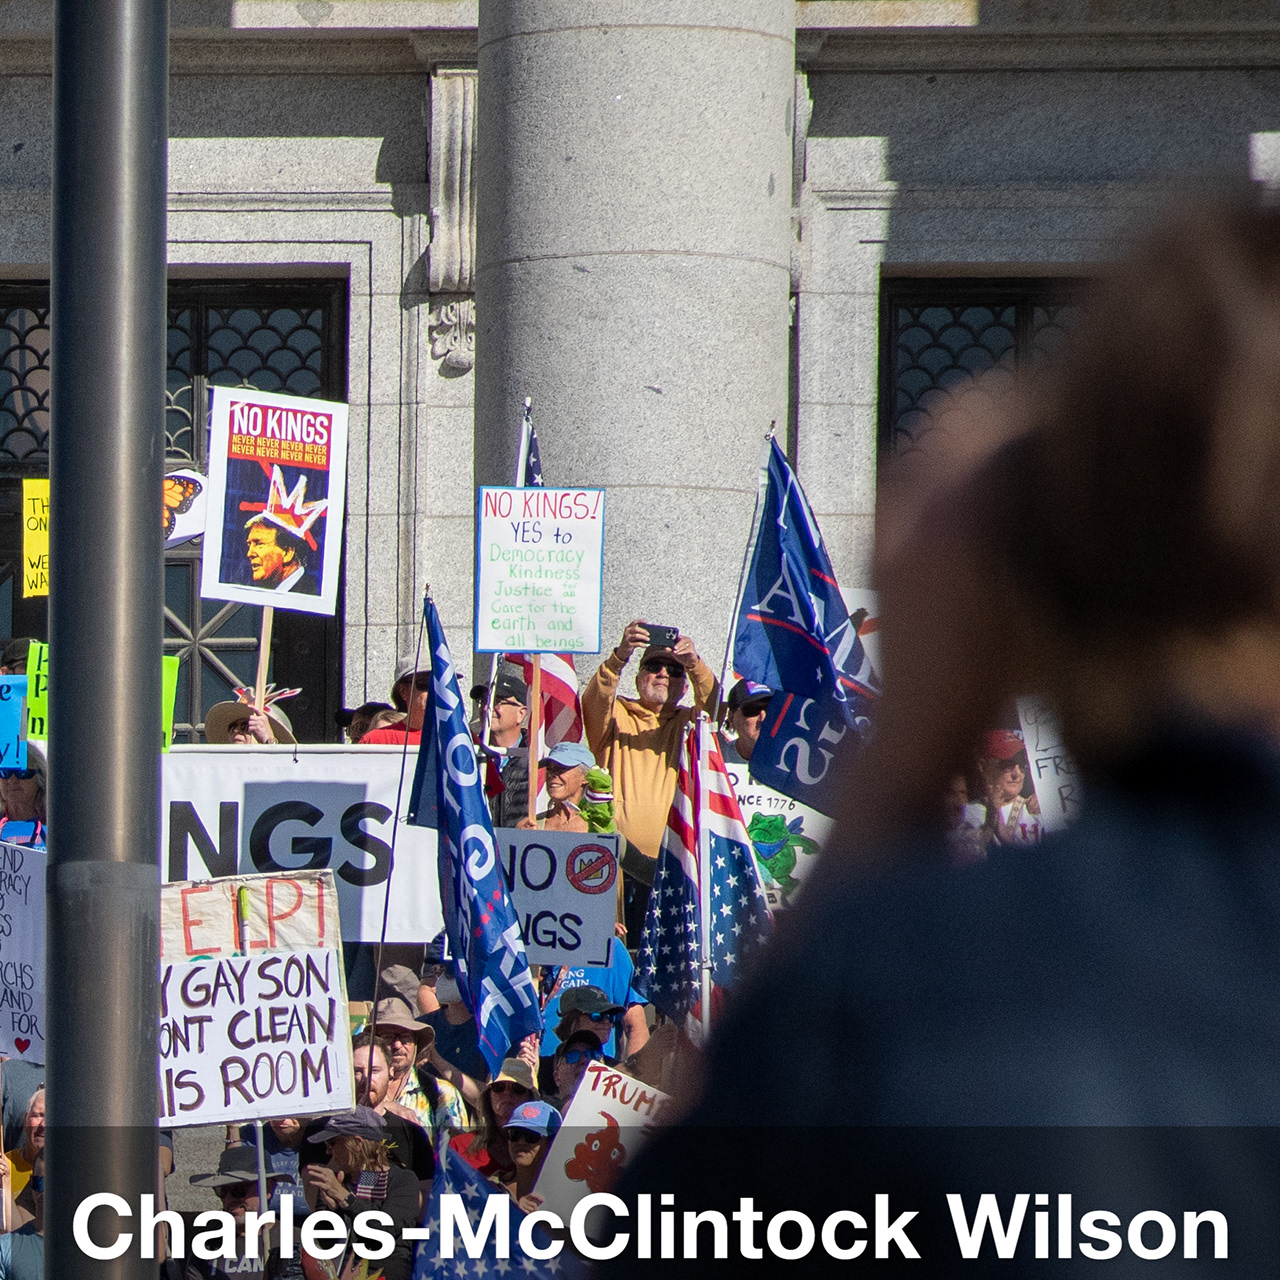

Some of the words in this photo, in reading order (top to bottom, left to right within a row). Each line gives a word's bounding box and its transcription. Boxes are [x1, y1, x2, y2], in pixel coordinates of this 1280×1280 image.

[233, 405, 262, 436] NO
[267, 409, 329, 445] KINGS
[233, 434, 255, 445] NEVER
[257, 437, 279, 448] NEVER
[281, 440, 303, 451] NEVER
[305, 444, 326, 455] NEVER
[485, 492, 512, 518] NO
[522, 491, 601, 520] KINGS!
[511, 521, 542, 543] YES
[554, 527, 572, 544] to
[490, 543, 585, 568] Democracy
[509, 564, 580, 579] Kindness
[494, 581, 552, 596] Justice
[491, 599, 523, 613] Care
[528, 601, 545, 613] for
[553, 601, 576, 614] the
[491, 614, 536, 630] earth
[547, 619, 572, 630] and
[505, 634, 525, 647] all
[536, 634, 584, 649] beings
[768, 796, 797, 811] 1776
[180, 965, 249, 1008] GAY
[256, 951, 330, 1000] SON
[0, 986, 34, 1011] AND
[11, 1014, 45, 1041] FOR
[226, 998, 336, 1049] CLEAN
[219, 1048, 333, 1106] ROOM
